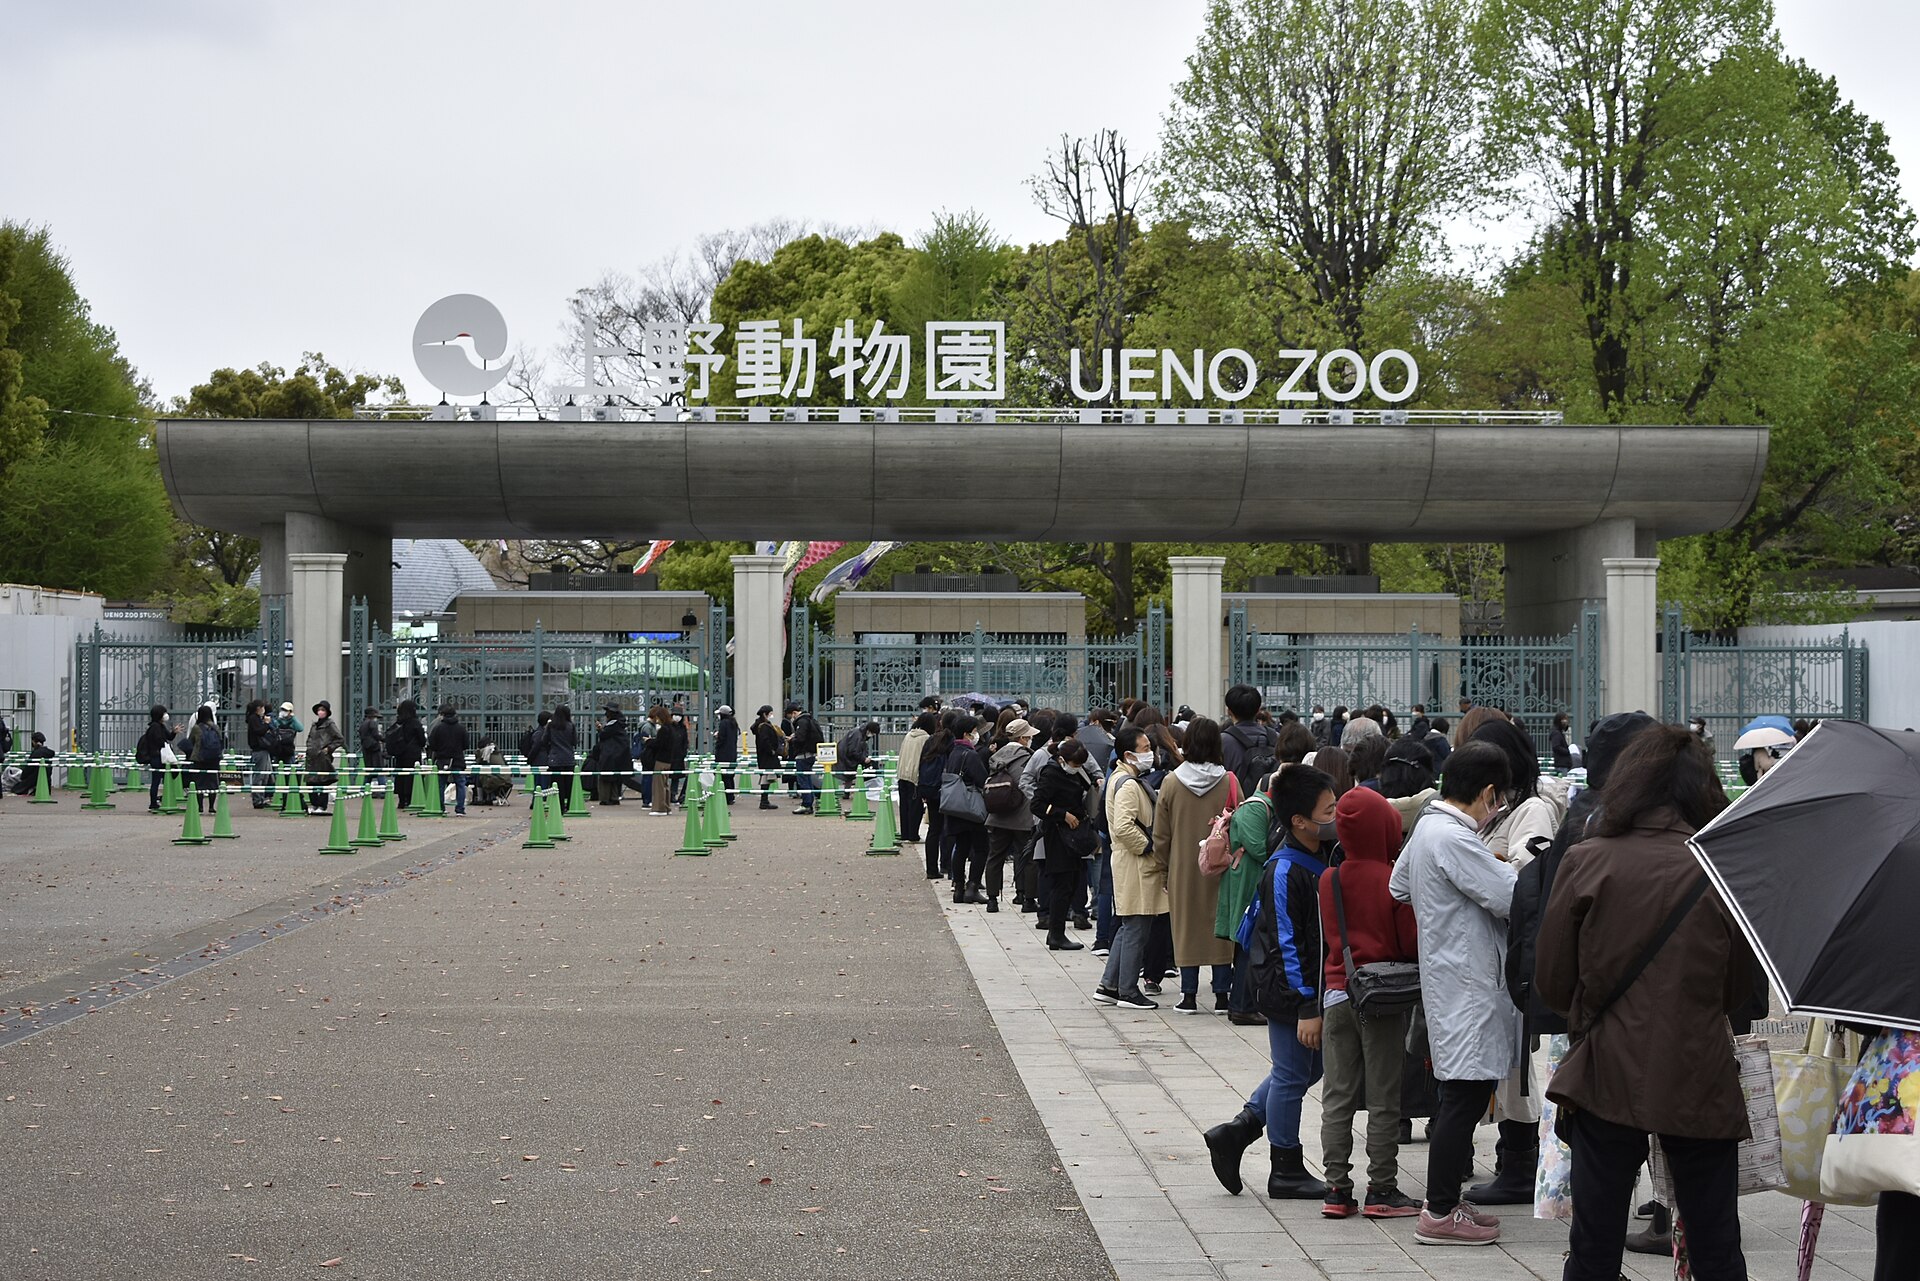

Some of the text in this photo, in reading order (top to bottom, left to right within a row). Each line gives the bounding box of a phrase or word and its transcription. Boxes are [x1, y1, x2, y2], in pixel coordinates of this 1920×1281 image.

[553, 318, 1005, 401] 上野動物園
[1070, 348, 1419, 402] UENO ZOO
